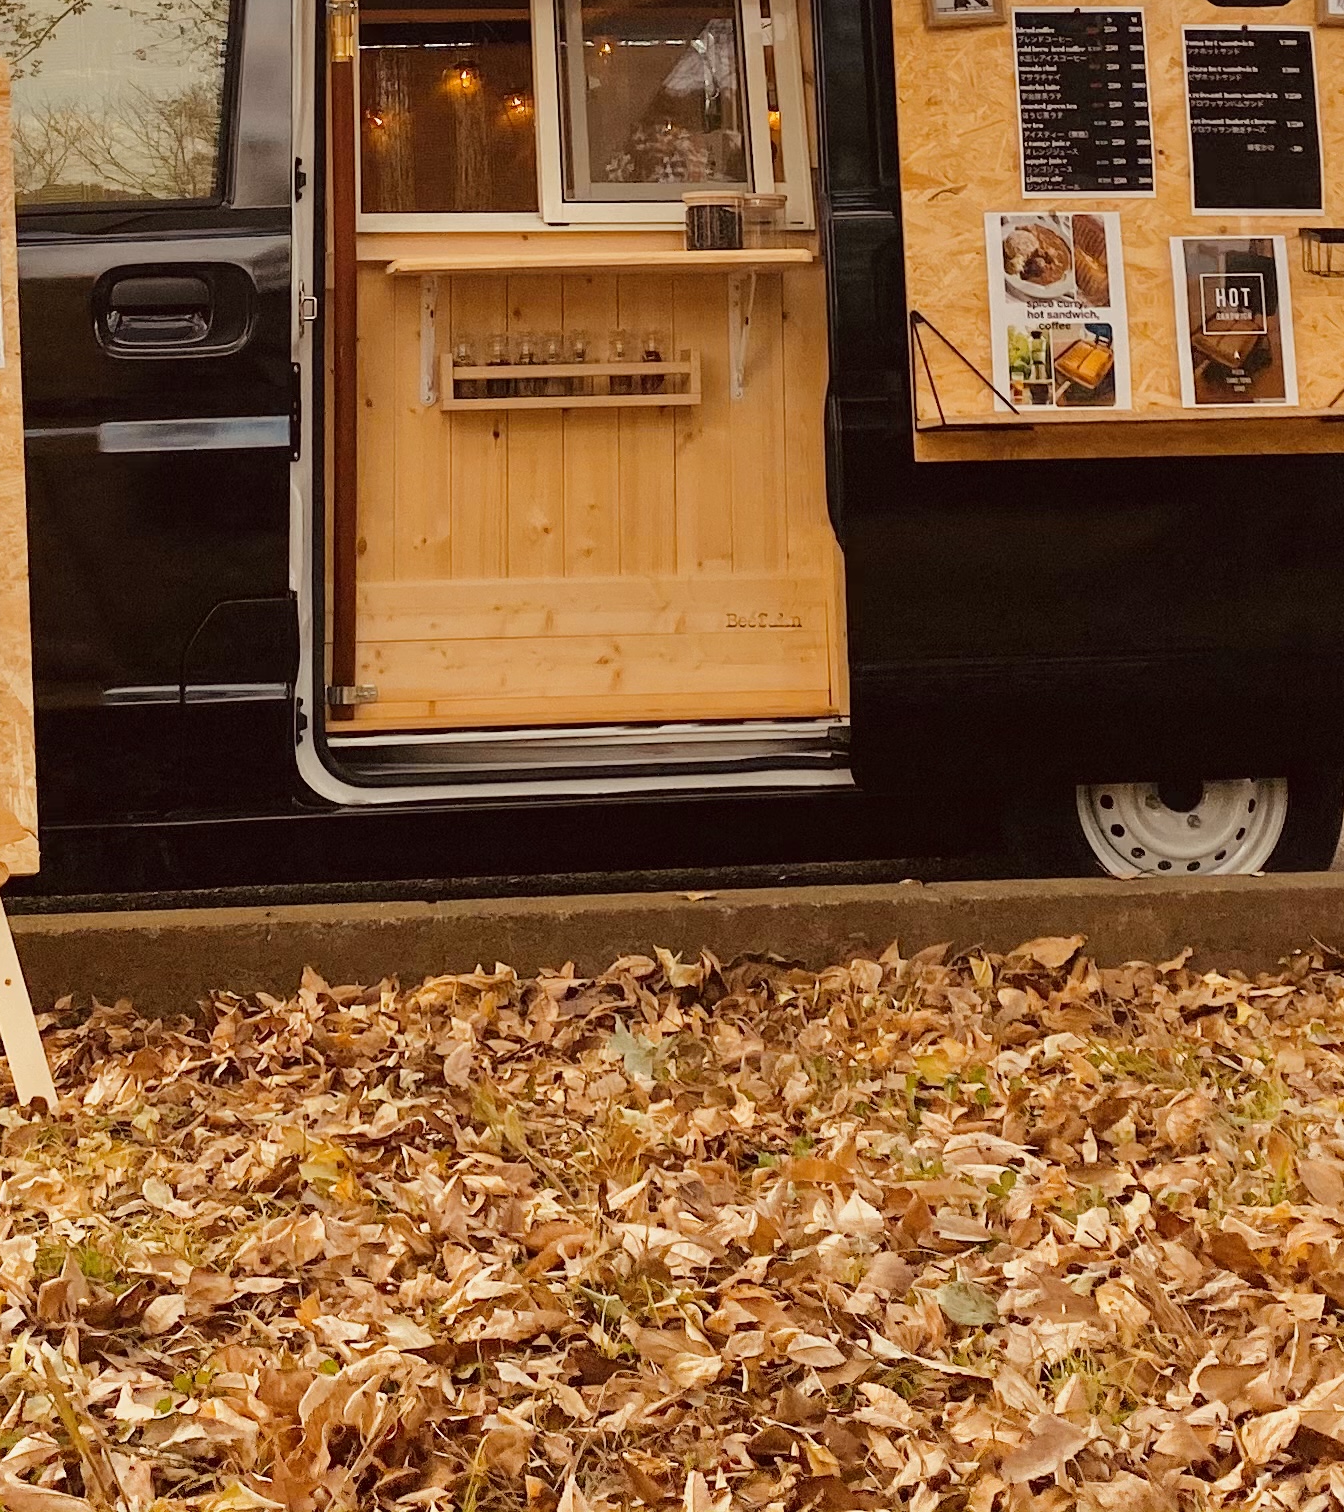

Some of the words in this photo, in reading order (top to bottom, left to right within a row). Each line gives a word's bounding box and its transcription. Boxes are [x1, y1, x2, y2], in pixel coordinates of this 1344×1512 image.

[1215, 288, 1250, 307] HOT
[1027, 311, 1044, 319] hot
[1216, 312, 1252, 320] SANDWICH
